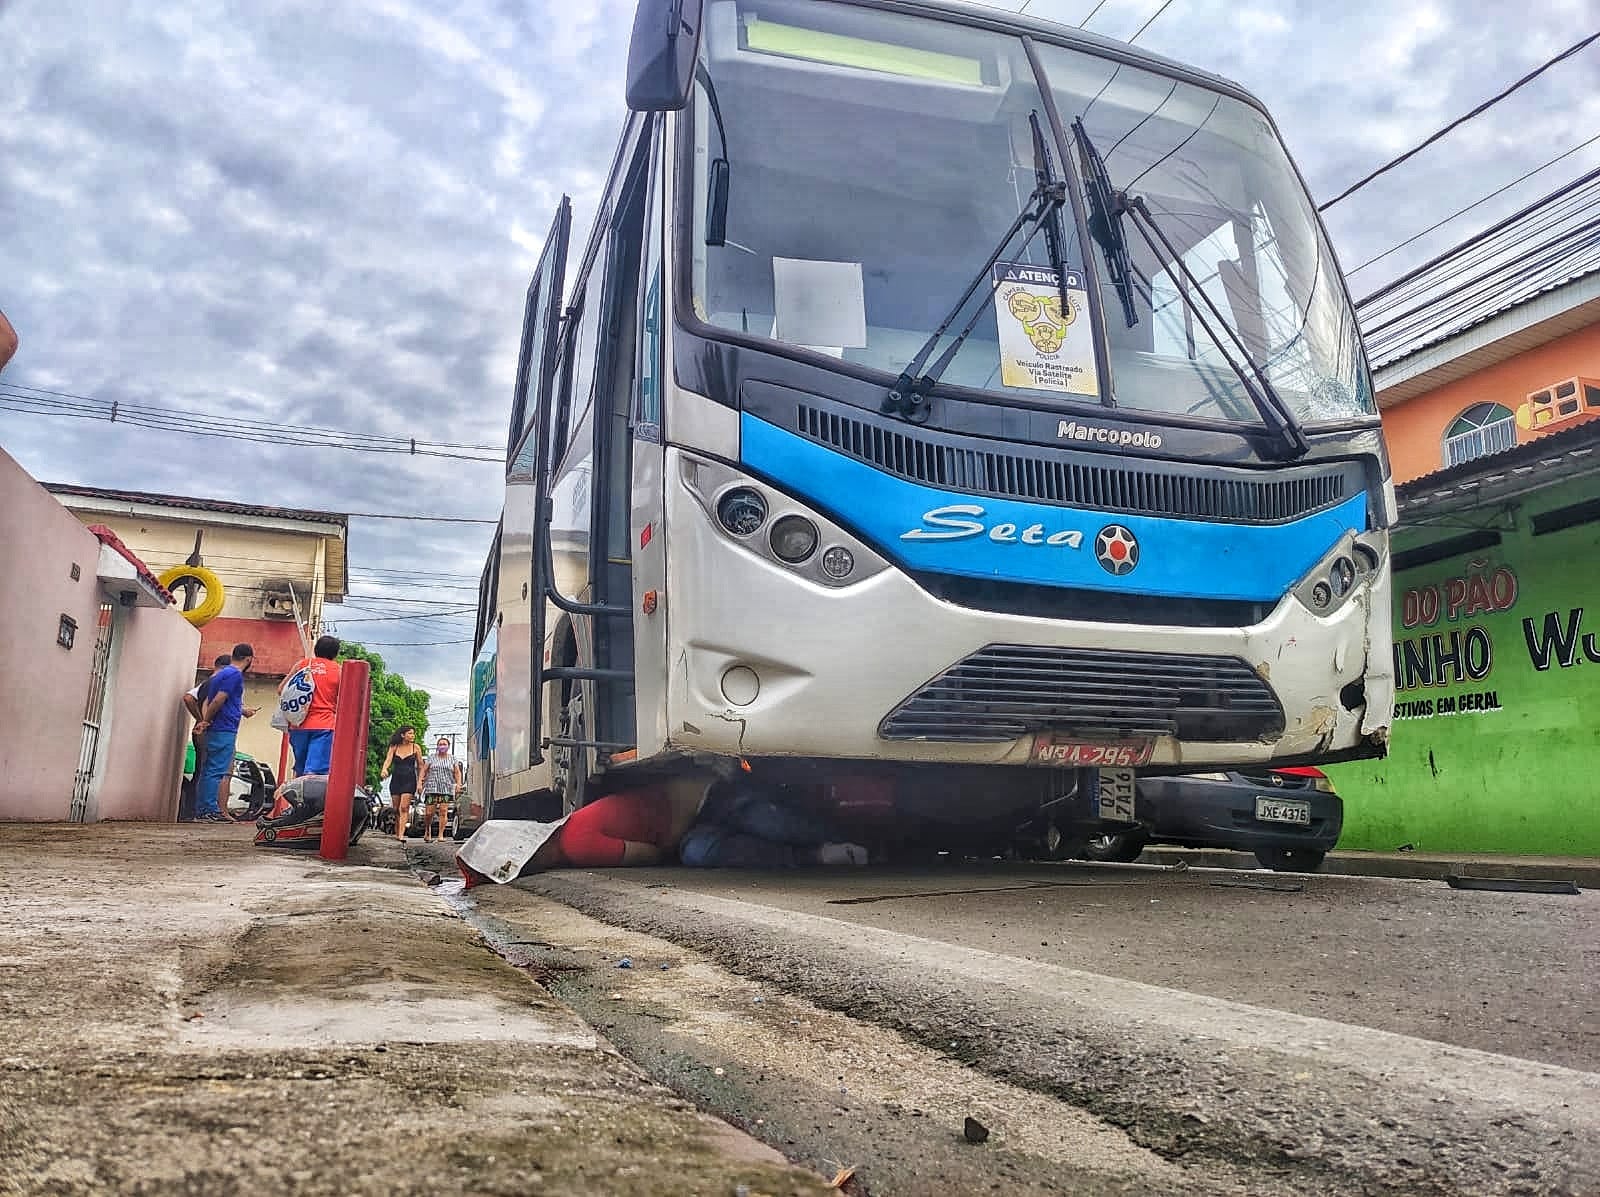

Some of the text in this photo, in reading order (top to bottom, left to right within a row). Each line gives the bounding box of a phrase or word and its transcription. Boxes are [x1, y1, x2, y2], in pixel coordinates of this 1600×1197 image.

[1018, 270, 1077, 286] ATENÇO
[1029, 368, 1042, 376] Via
[1057, 420, 1163, 449] Marcopolo
[899, 504, 1083, 549] Seta
[1403, 559, 1517, 628] DO PÃO
[1436, 696, 1456, 715] EM
[1458, 690, 1504, 714] GERAL
[1116, 772, 1131, 815] 7A16
